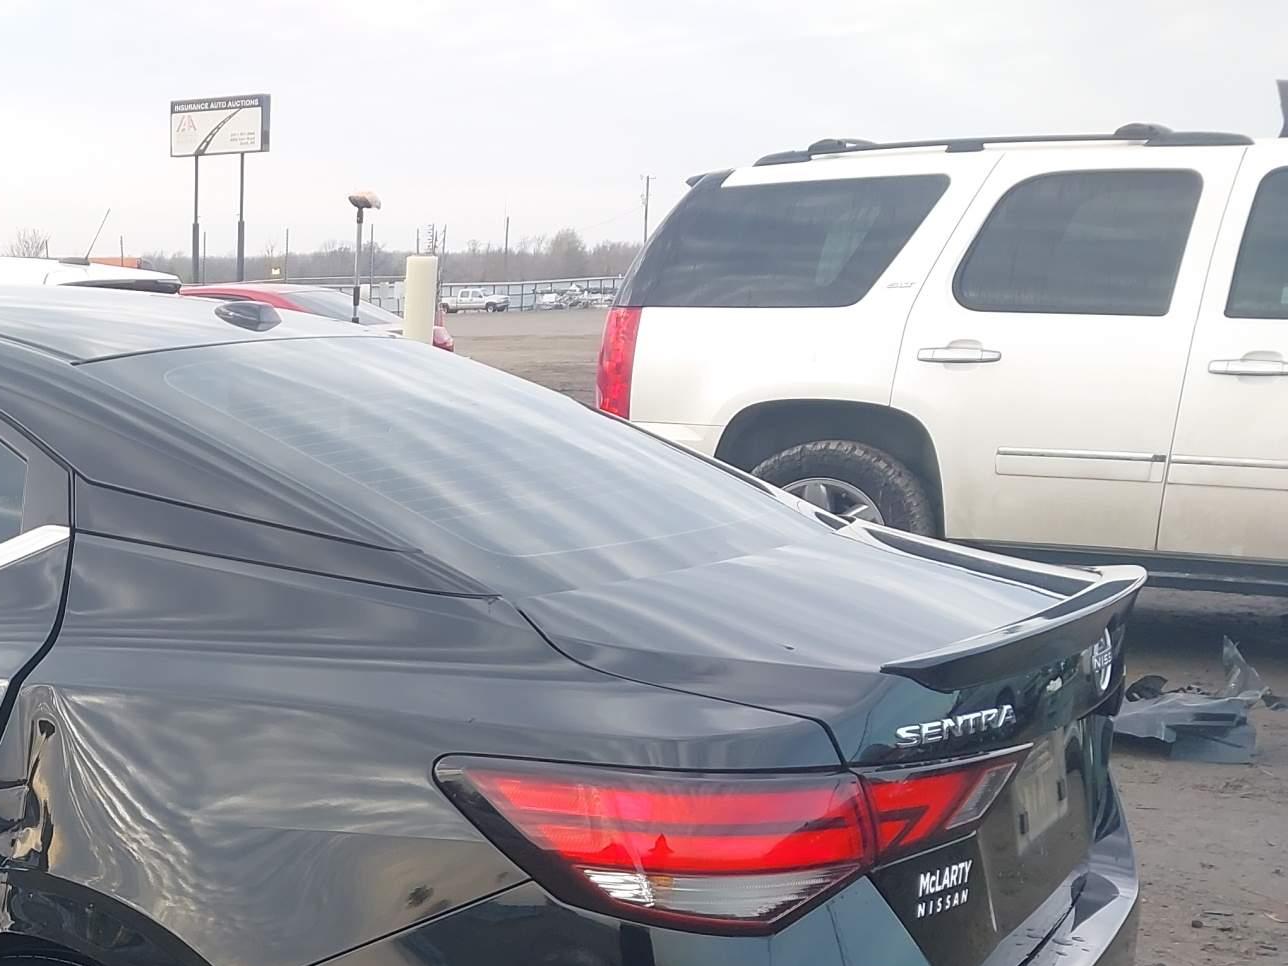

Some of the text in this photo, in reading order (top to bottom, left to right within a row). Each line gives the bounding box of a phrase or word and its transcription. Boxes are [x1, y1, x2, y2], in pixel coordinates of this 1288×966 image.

[174, 98, 259, 112] INSURANCE AUTO AUCTIONS
[896, 704, 1017, 748] SENTRA
[918, 860, 973, 898] McLARTY
[917, 888, 969, 919] NISSAN
